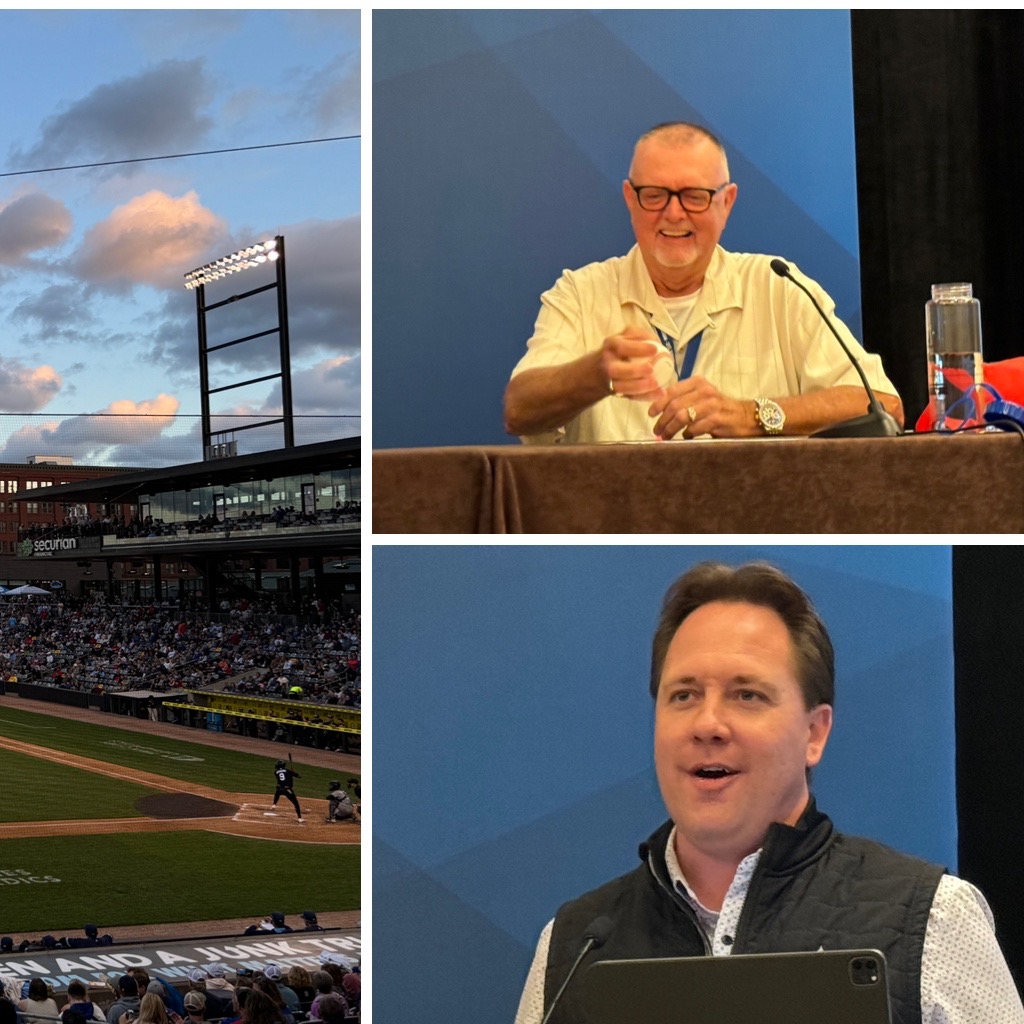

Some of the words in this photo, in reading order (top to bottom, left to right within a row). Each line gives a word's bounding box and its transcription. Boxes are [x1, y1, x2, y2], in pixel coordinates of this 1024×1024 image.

[33, 537, 77, 552] securian
[279, 772, 286, 781] 9
[54, 953, 152, 974] AND
[155, 950, 197, 965] A
[194, 940, 314, 962] JUNK
